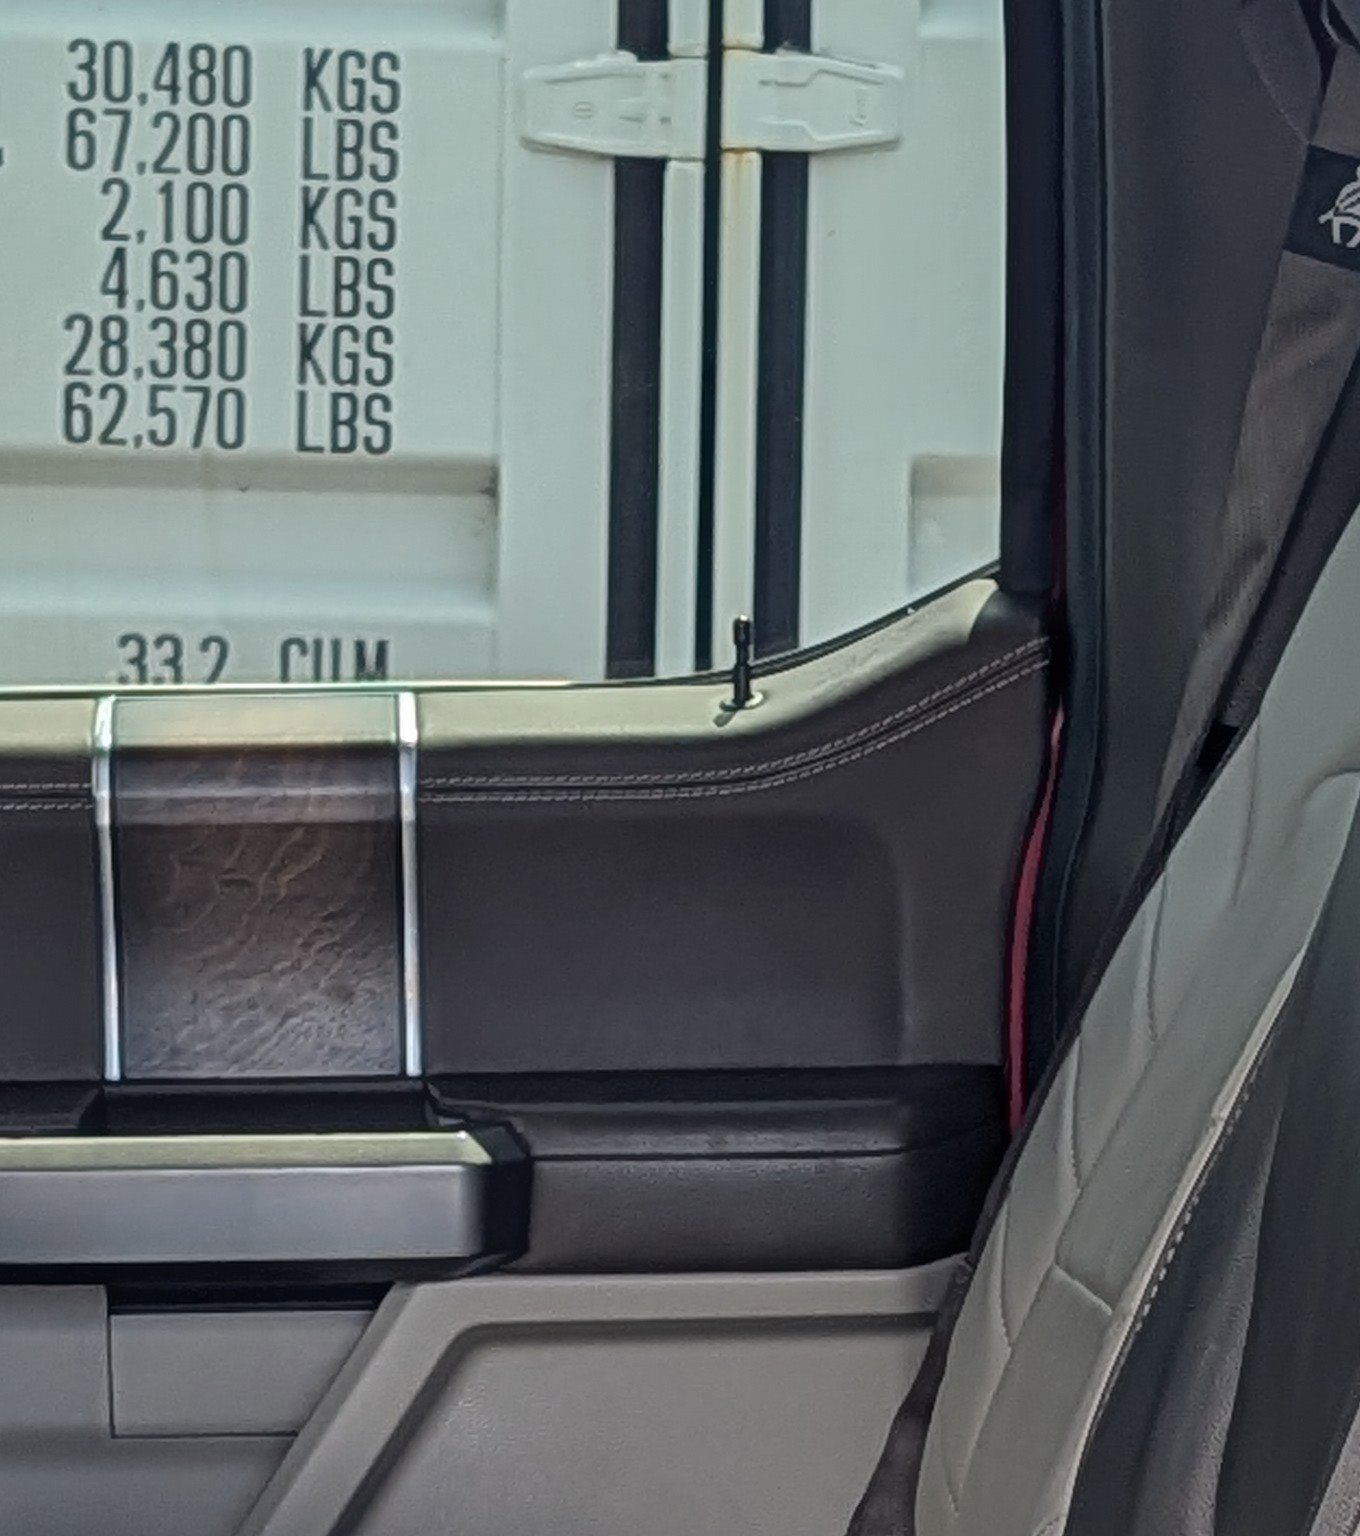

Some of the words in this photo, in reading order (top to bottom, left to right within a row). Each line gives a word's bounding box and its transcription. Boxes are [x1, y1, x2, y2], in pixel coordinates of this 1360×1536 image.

[67, 38, 251, 109] 30,480
[303, 47, 400, 115] KGS
[66, 107, 250, 177] 67,200
[302, 116, 399, 183] LBS
[101, 177, 249, 247] 2,100
[300, 185, 397, 252] KGS
[100, 246, 248, 315] 4,630
[299, 254, 394, 320] LBS
[64, 313, 247, 382] 28,380
[298, 322, 394, 388] KGS
[63, 381, 245, 450] 62,570
[296, 390, 392, 457] LBS
